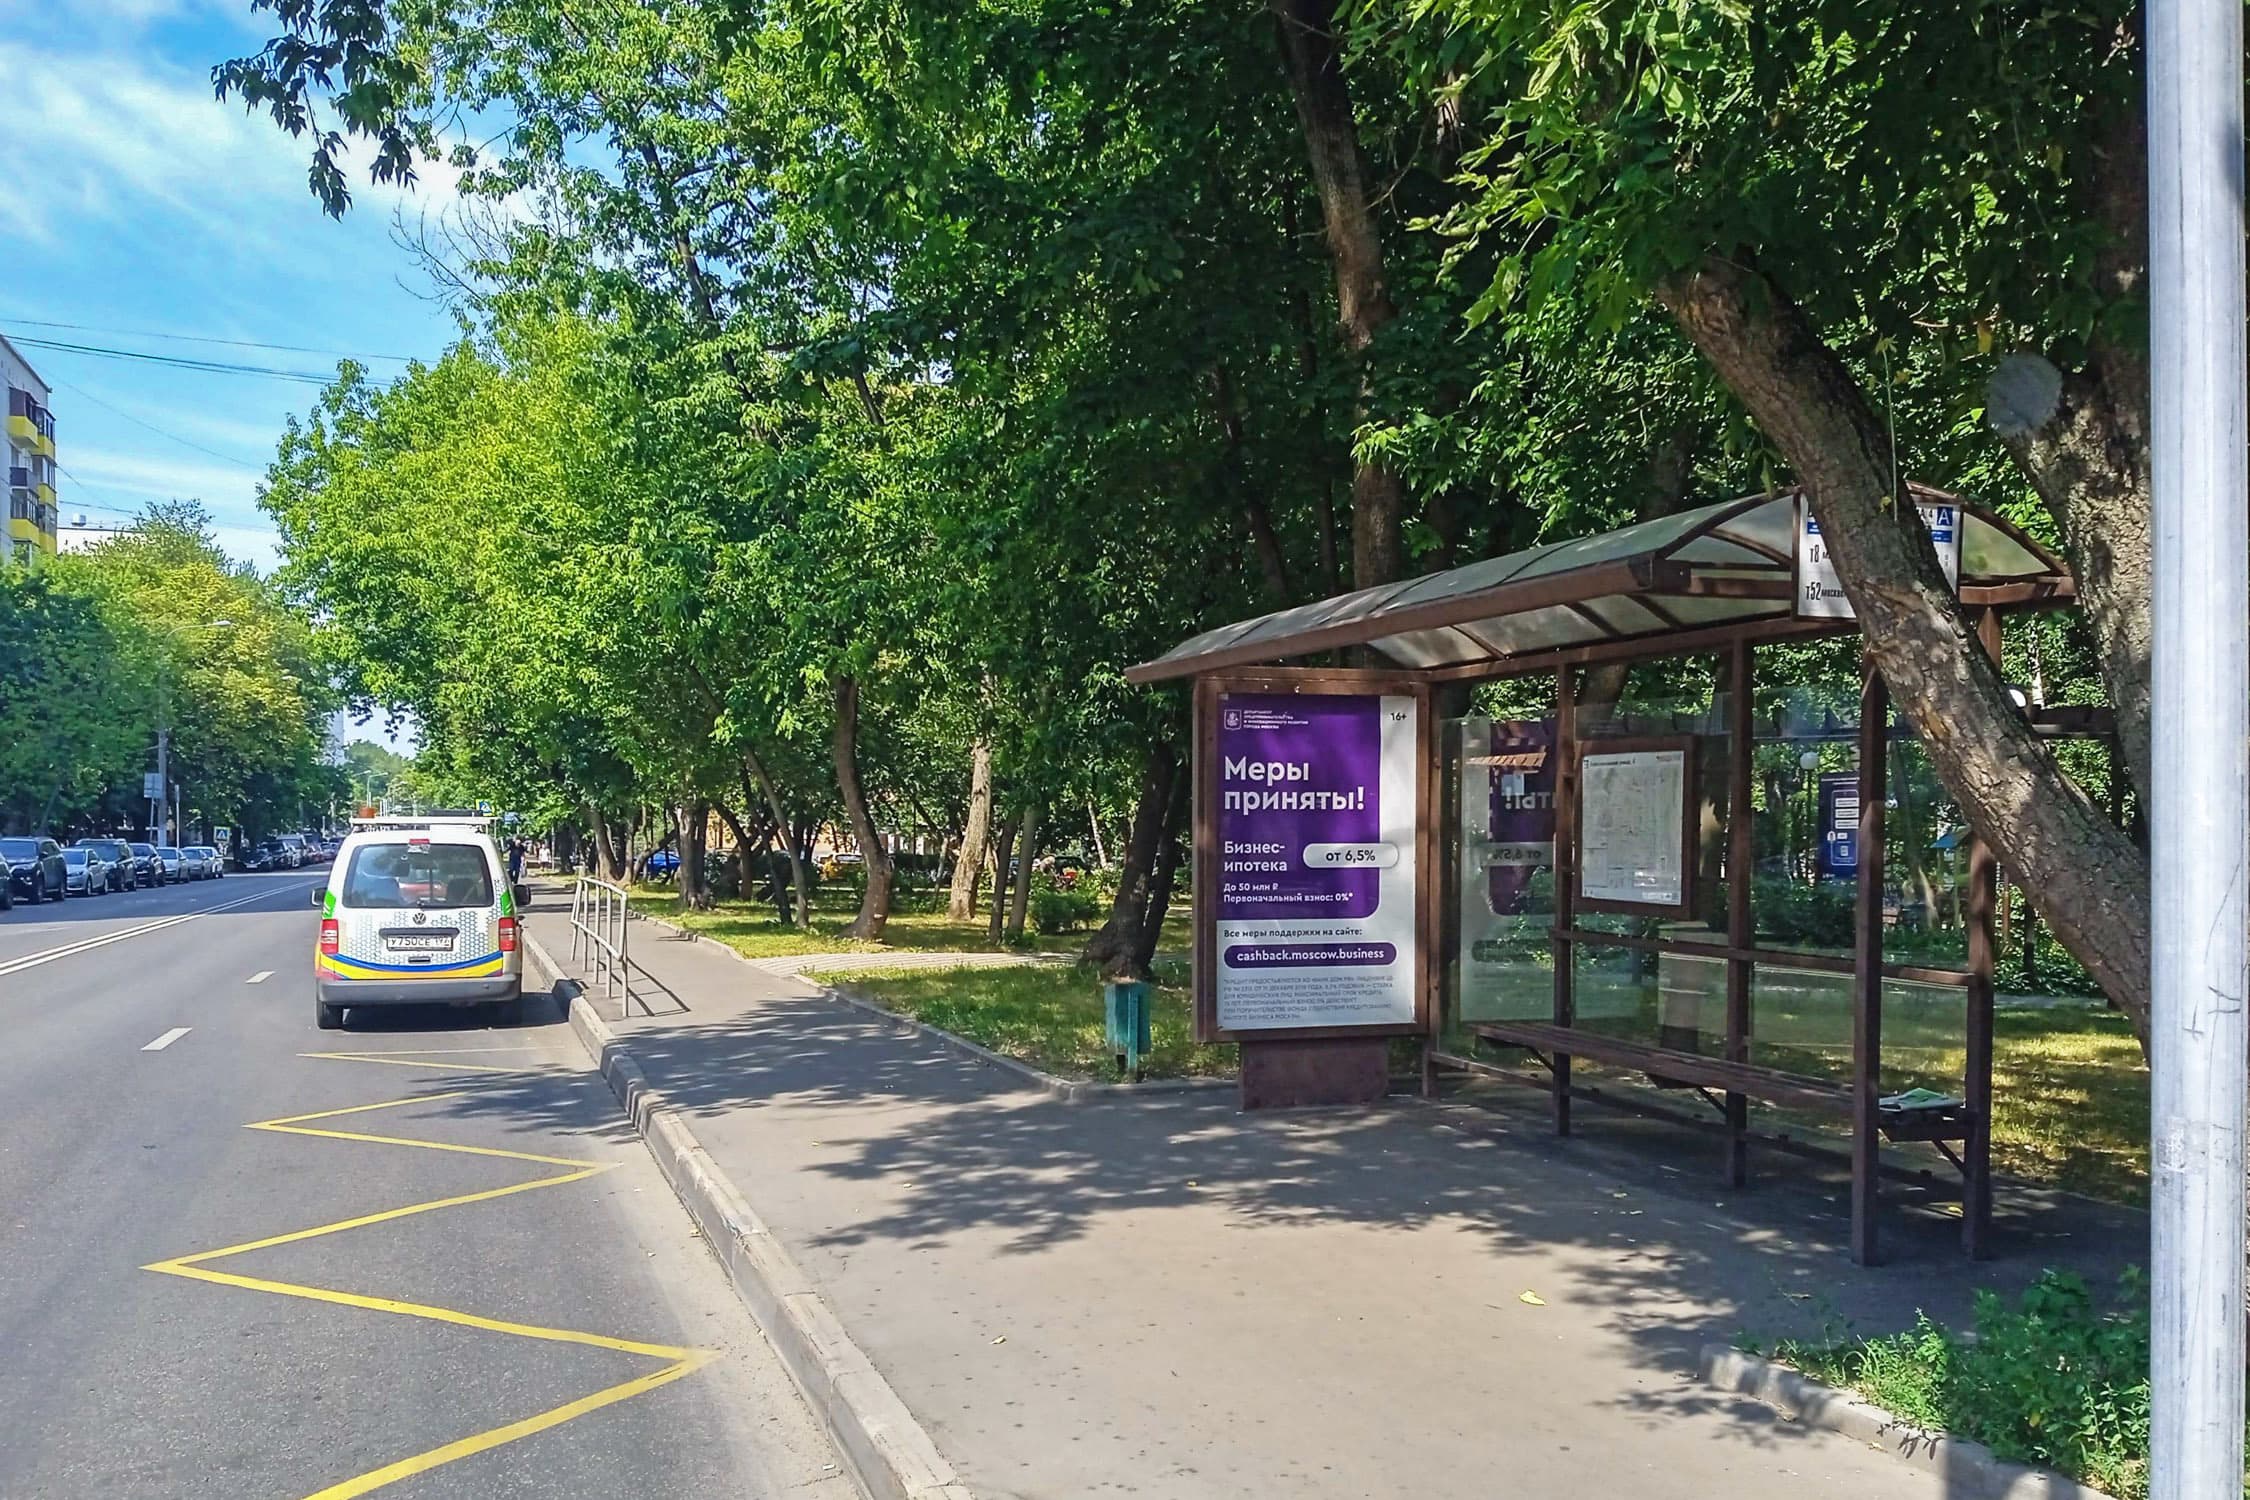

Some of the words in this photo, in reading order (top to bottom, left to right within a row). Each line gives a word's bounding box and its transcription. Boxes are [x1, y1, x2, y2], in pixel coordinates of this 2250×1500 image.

[1390, 712, 1407, 721] 16+
[1224, 756, 1309, 786] Меры
[1224, 786, 1365, 816] приняты!
[1224, 840, 1286, 854] Бизнес-
[1326, 852, 1341, 862] от
[1345, 849, 1376, 863] 6,5%
[1224, 860, 1288, 873] ипотека
[1223, 883, 1237, 893] До
[1238, 882, 1250, 891] 50
[1252, 884, 1271, 892] млн
[1223, 892, 1303, 904] Первоначальный
[1304, 893, 1334, 902] взнос:
[1224, 929, 1240, 938] Все
[1242, 930, 1267, 939] меры
[1269, 929, 1321, 938] поддержки
[1335, 927, 1363, 936] сайте:
[1236, 948, 1385, 962] cashback.moscow.business
